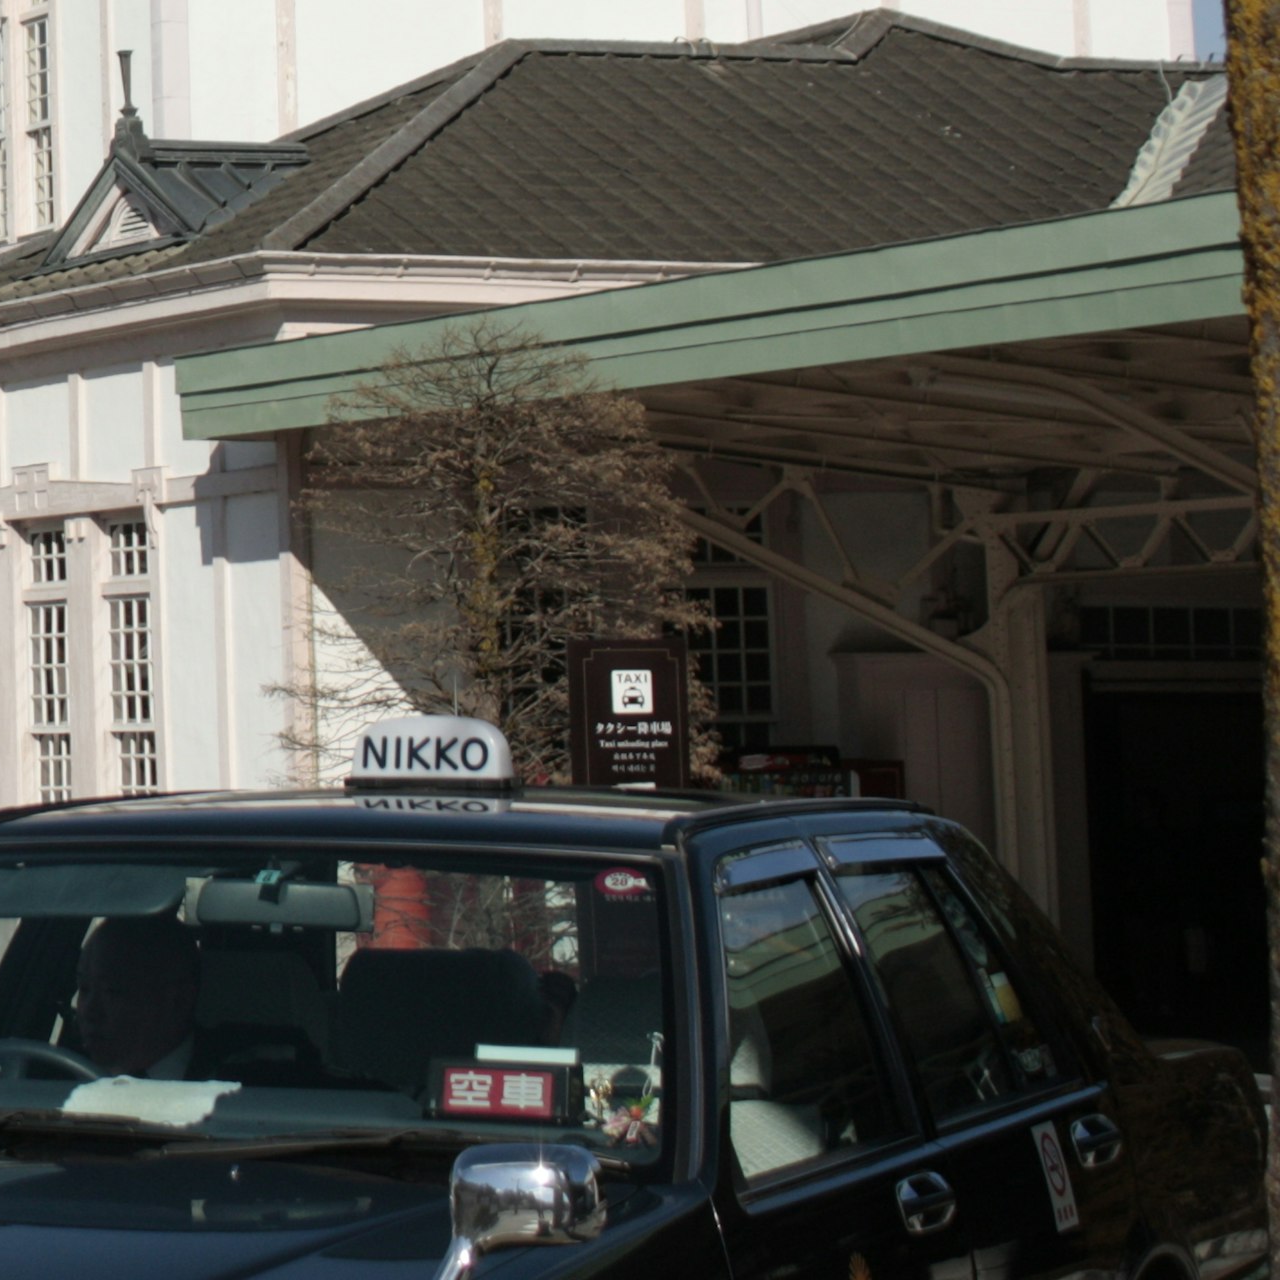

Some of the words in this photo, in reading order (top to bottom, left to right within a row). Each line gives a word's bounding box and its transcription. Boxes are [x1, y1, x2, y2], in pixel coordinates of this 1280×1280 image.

[616, 673, 648, 684] TAXI
[599, 740, 616, 748] Taxi
[362, 736, 488, 771] NIKKO
[611, 877, 628, 887] 28
[448, 1071, 545, 1109] 空車
